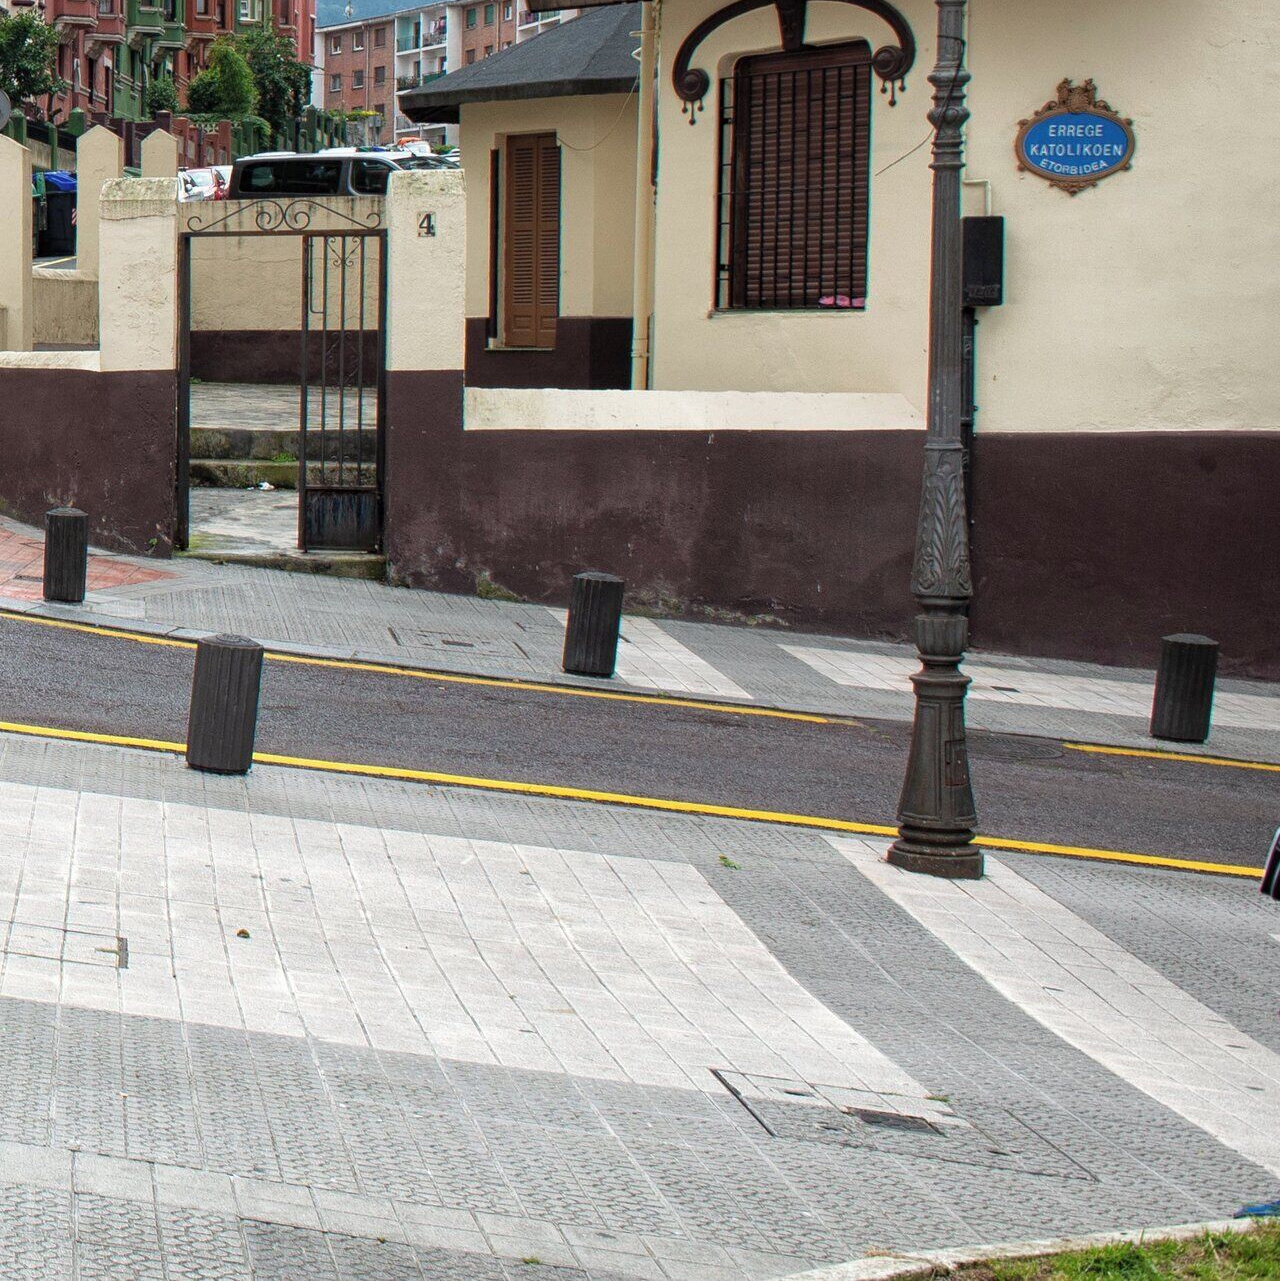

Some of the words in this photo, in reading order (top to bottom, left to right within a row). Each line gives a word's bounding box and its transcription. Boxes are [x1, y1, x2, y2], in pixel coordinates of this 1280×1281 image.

[1048, 124, 1104, 137] ERREGE
[1030, 143, 1123, 156] KATOLIKOEN
[1040, 158, 1108, 175] ETORBIDEA
[419, 213, 435, 236] 4
